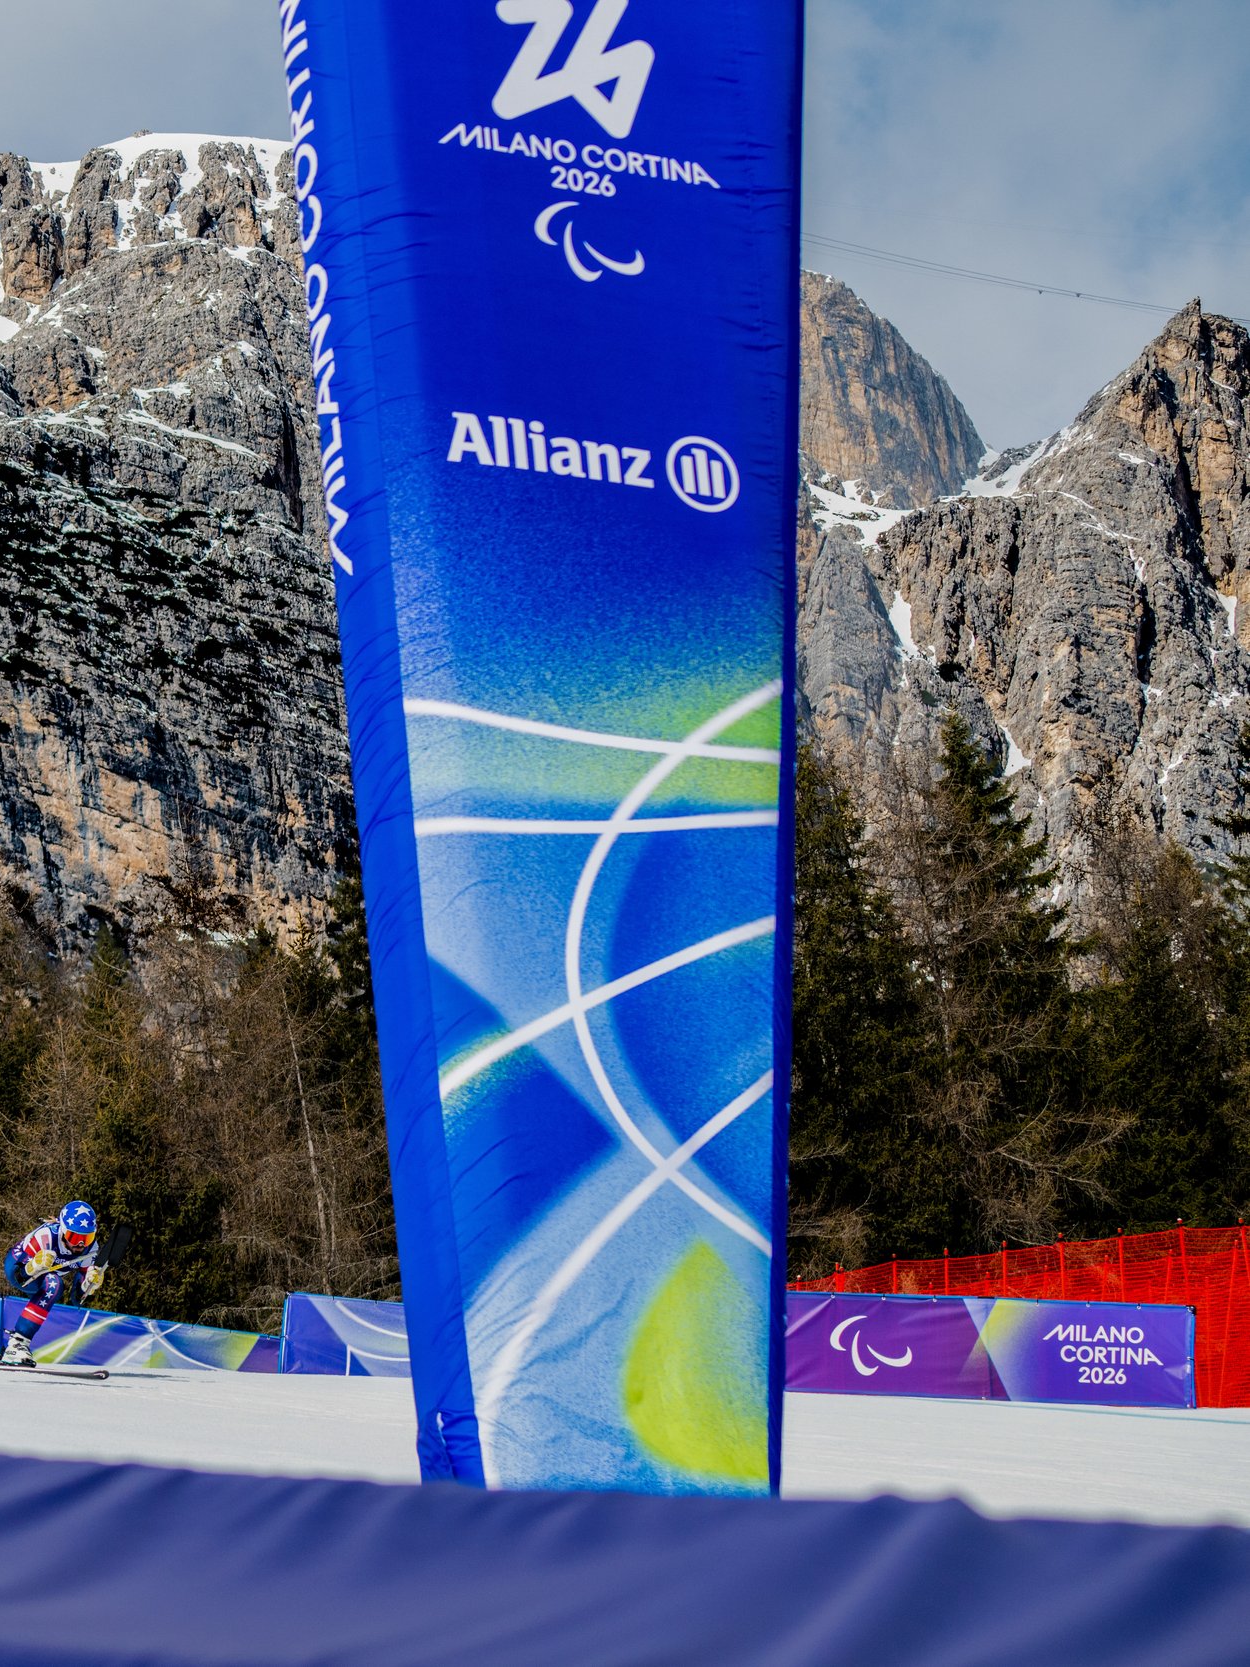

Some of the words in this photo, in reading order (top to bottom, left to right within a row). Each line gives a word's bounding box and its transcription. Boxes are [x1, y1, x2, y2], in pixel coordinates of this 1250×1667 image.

[438, 122, 578, 164] MILANO
[581, 143, 721, 189] CORTINA
[550, 165, 617, 198] 2026
[305, 262, 354, 576] MILANO
[446, 411, 655, 489] Allianz
[1042, 1324, 1145, 1344] MILANO
[1060, 1344, 1164, 1366] CORTINA
[1078, 1366, 1127, 1385] 2026
